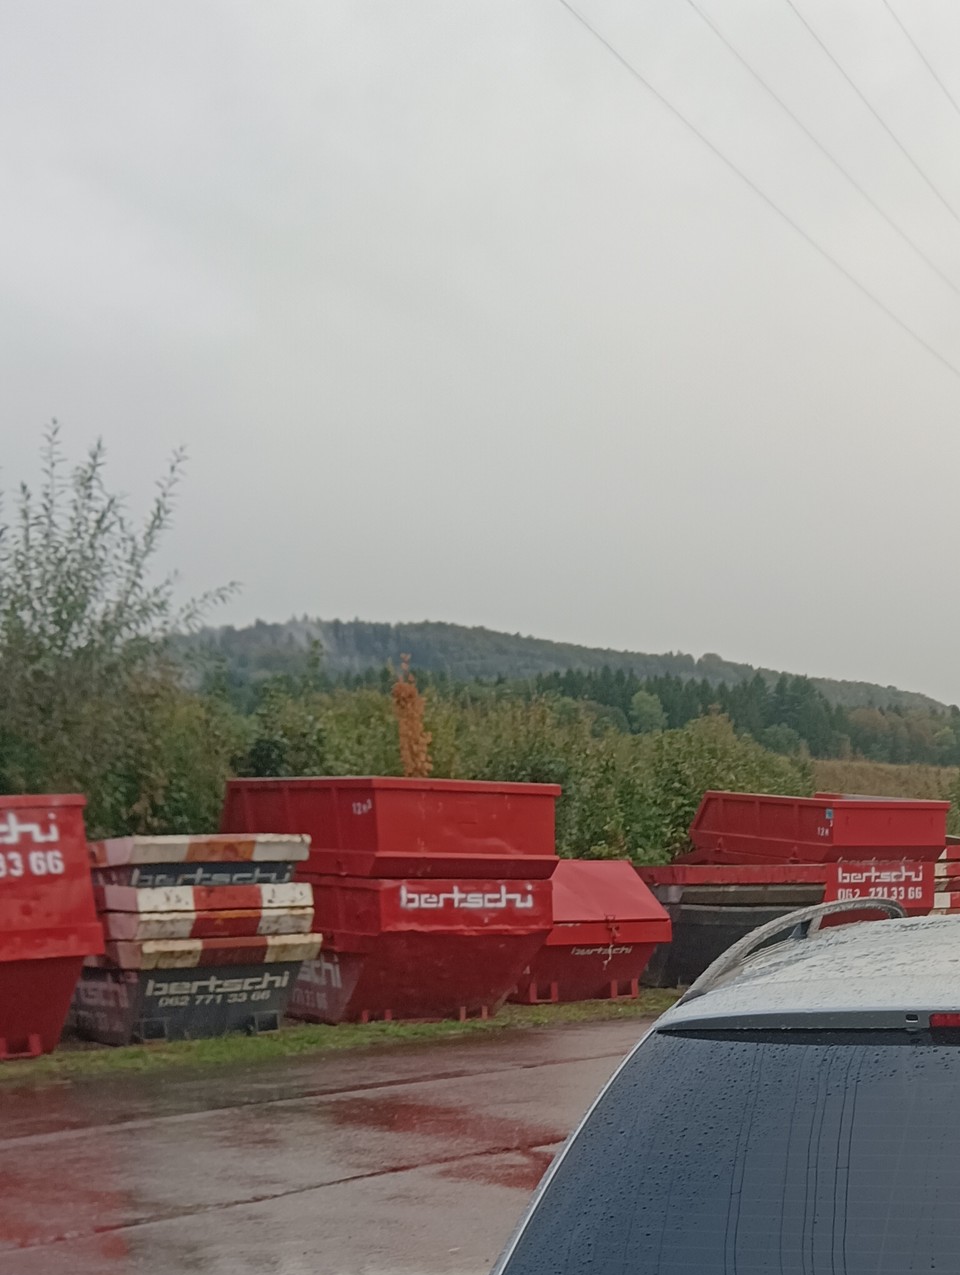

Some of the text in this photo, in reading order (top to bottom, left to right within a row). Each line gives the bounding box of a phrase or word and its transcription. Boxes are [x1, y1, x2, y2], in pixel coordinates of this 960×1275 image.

[29, 850, 65, 876] 66
[838, 865, 923, 883] bertschi
[131, 865, 293, 886] bertschi
[400, 884, 533, 908] bertschi
[145, 971, 290, 996] bertschi
